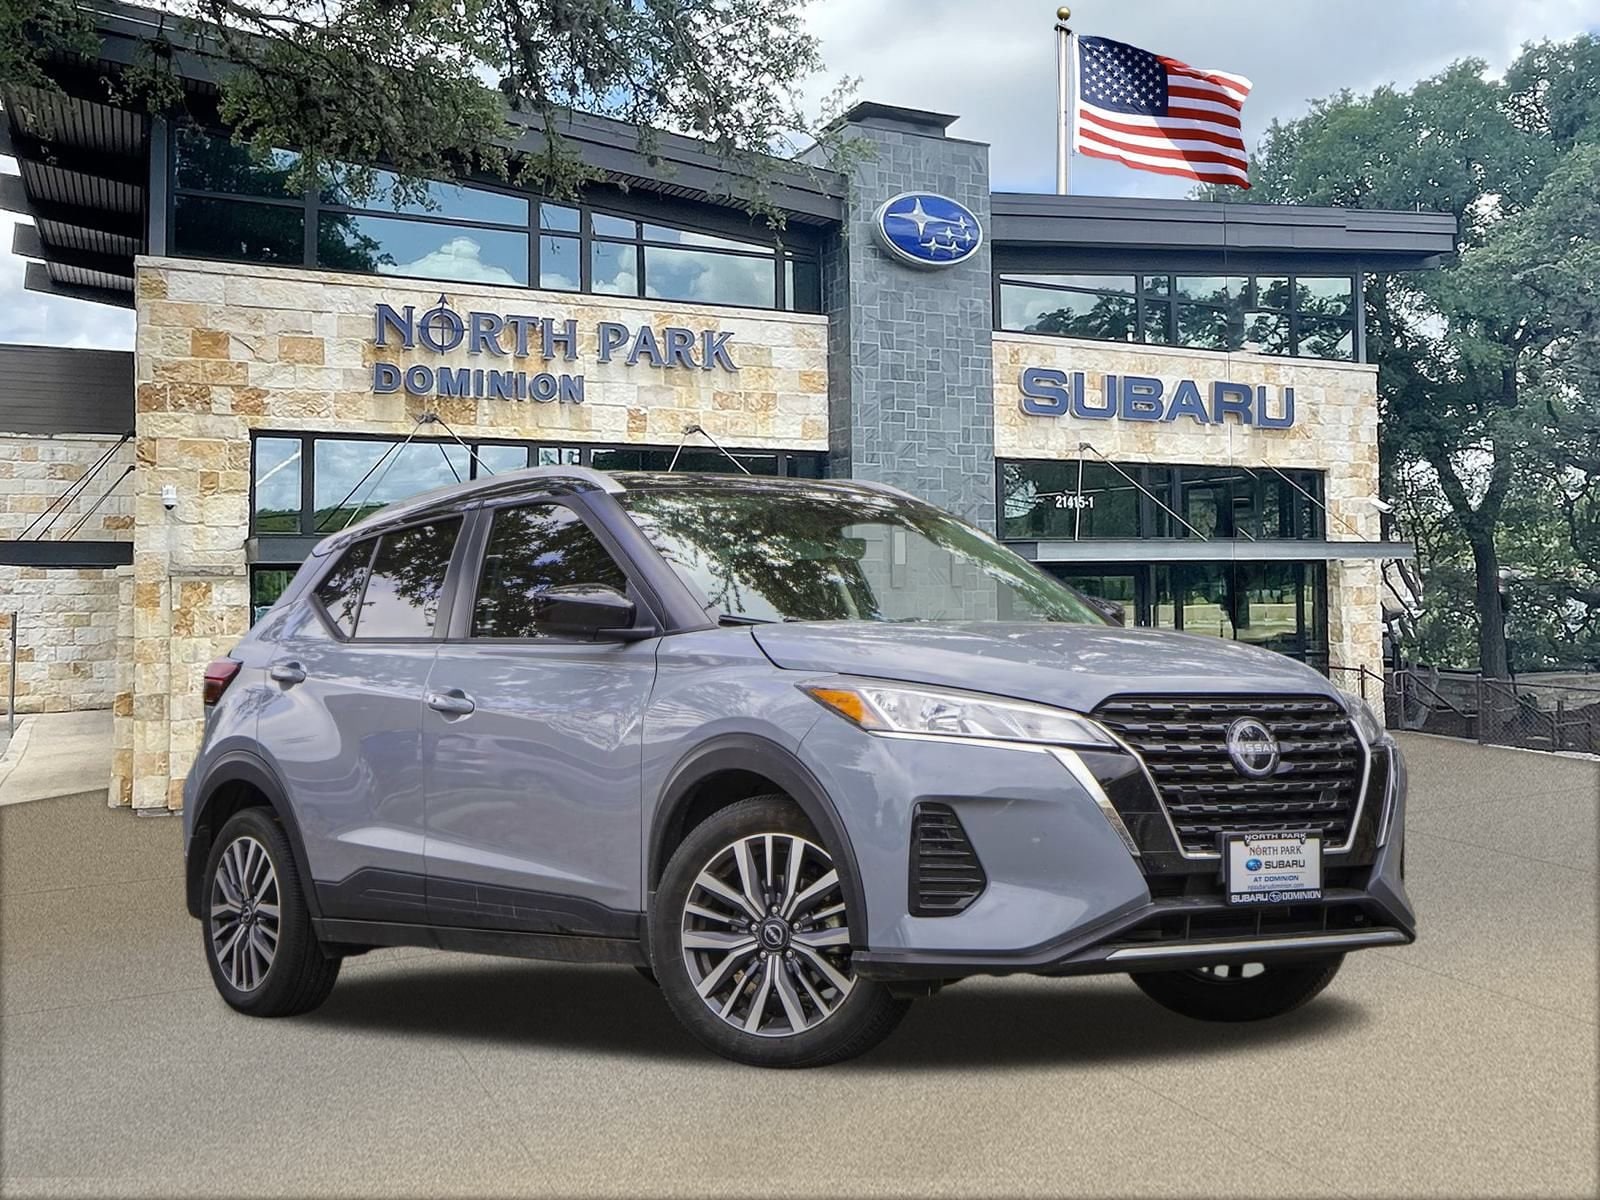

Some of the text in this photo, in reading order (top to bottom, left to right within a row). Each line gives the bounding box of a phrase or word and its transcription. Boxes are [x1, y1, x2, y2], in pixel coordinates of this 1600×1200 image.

[374, 293, 742, 373] NORTH PARK
[373, 361, 585, 404] DOMINION
[1019, 366, 1295, 430] SUBARU
[1244, 832, 1306, 841] NORTH PARK
[1249, 845, 1303, 856] NORTH PARK
[1264, 859, 1306, 869] SUBARU
[1231, 890, 1321, 903] SUBARU DOMINION
